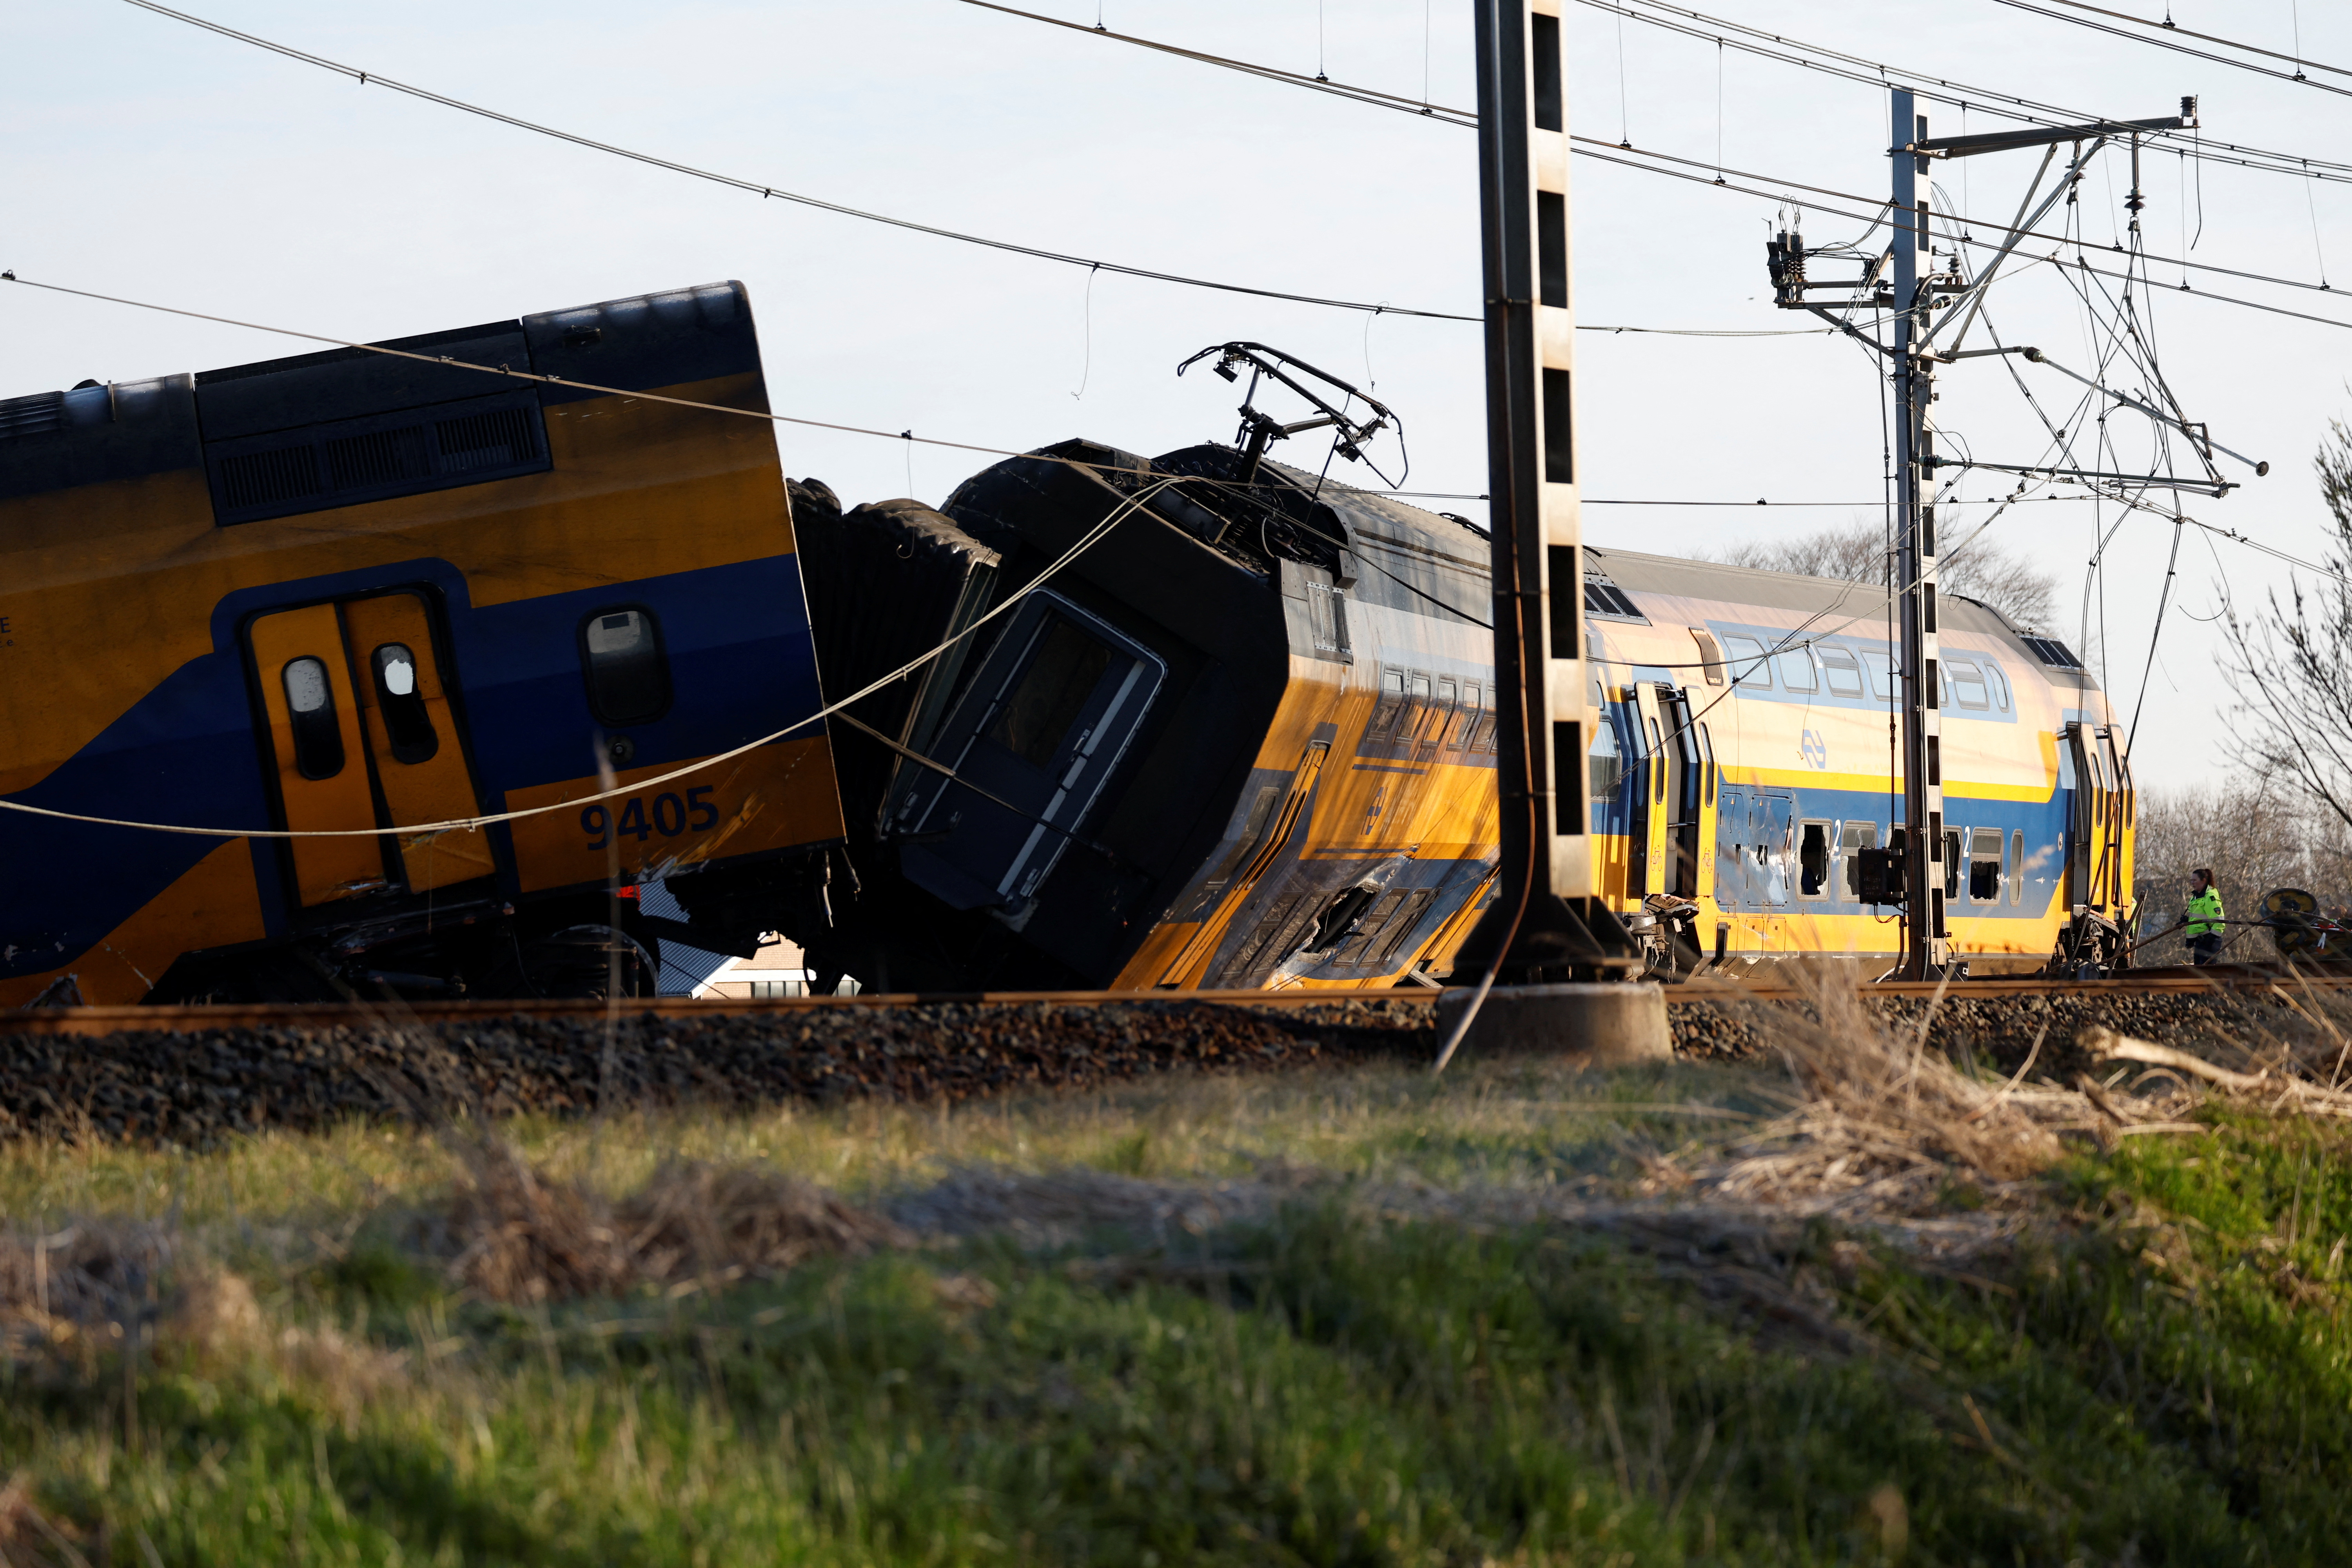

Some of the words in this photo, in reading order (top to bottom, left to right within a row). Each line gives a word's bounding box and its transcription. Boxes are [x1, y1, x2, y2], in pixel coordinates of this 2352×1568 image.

[581, 785, 719, 851] 9405
[1833, 819, 1841, 852] 2
[1963, 826, 1970, 857] 2
